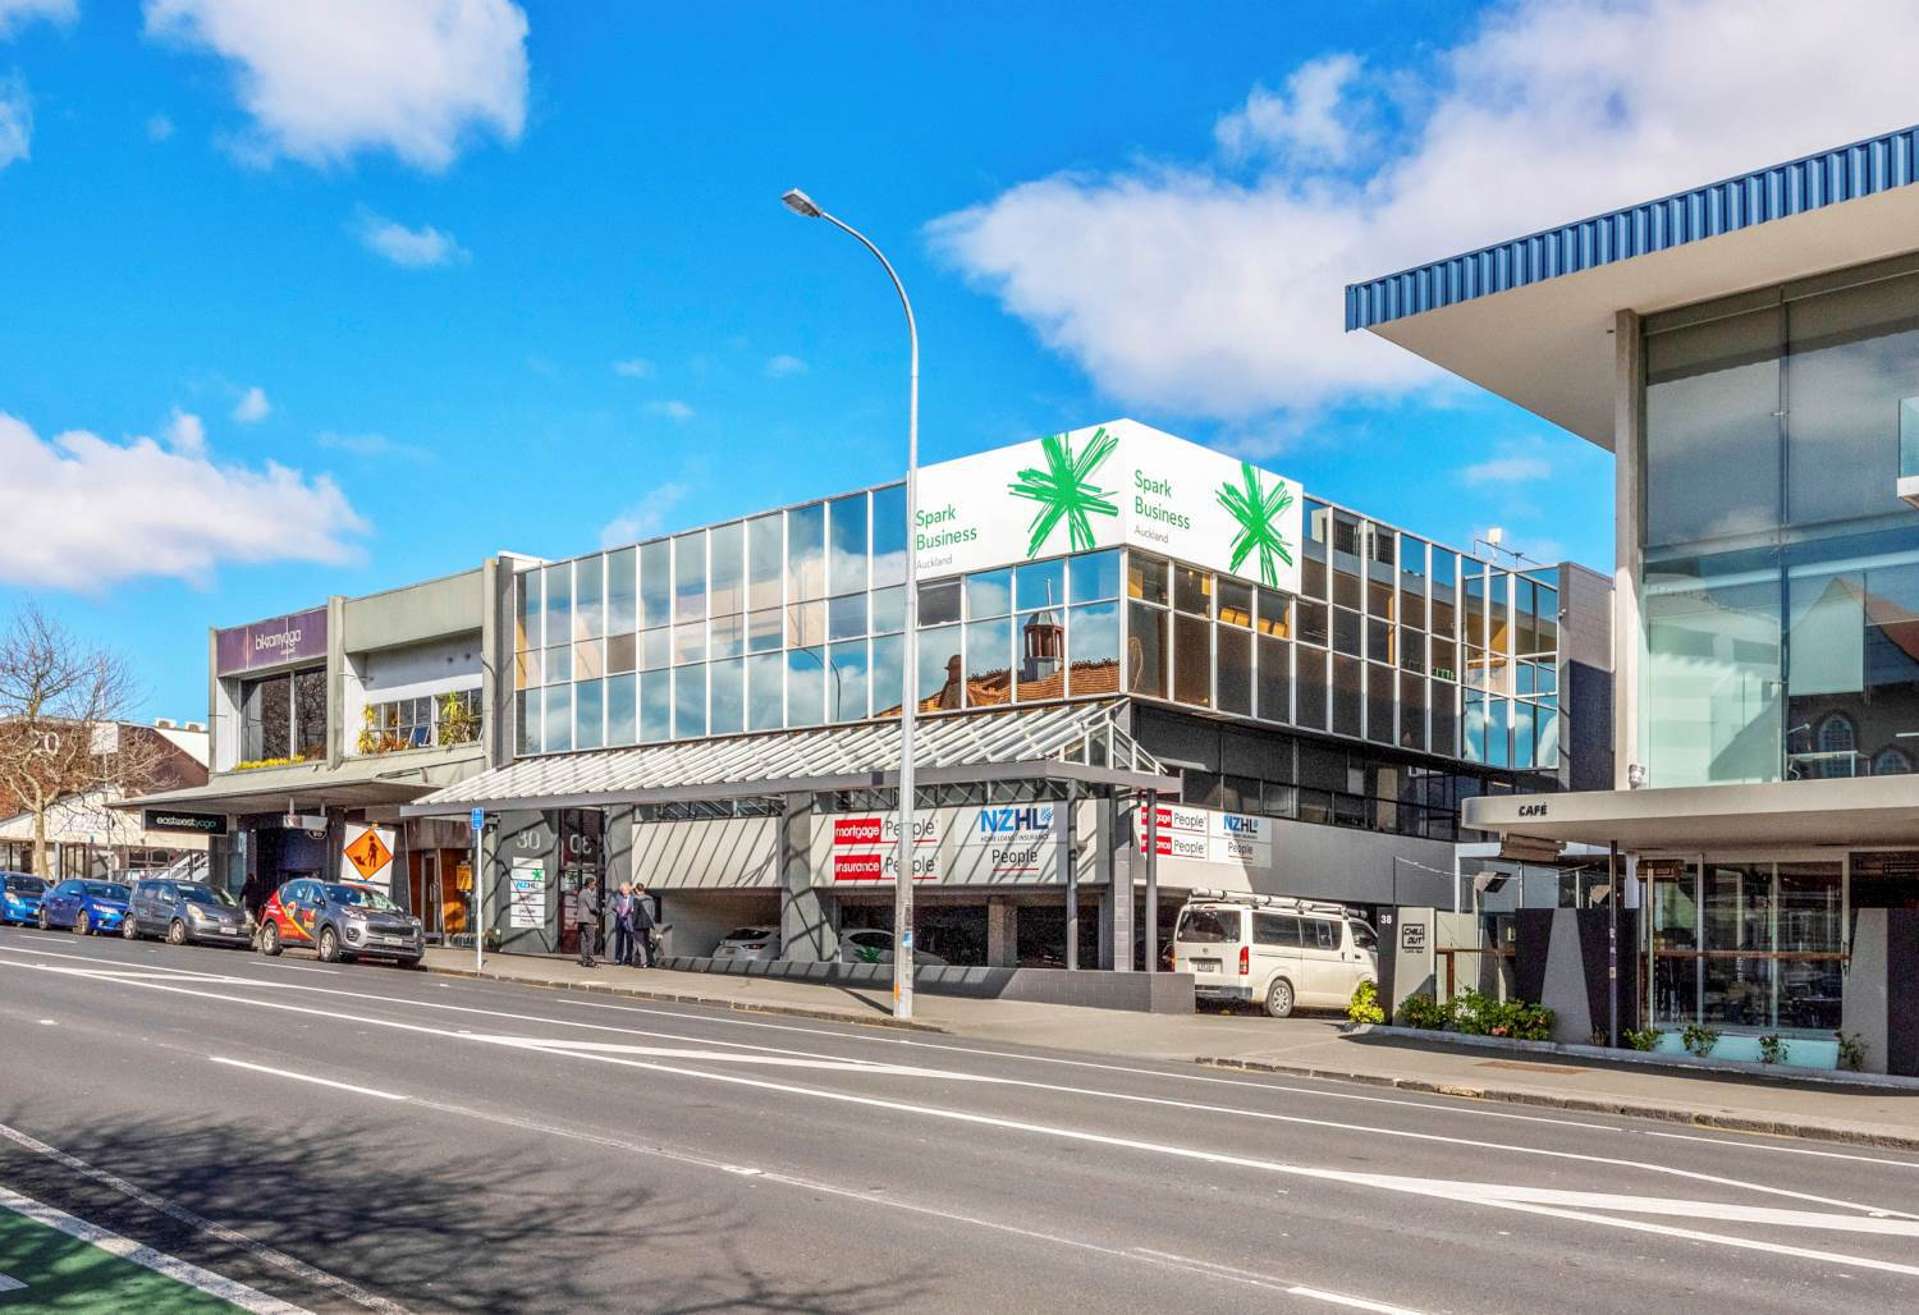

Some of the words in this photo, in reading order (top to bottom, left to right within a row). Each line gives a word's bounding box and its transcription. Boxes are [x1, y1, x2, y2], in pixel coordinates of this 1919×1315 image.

[1135, 469, 1172, 499] Spark
[915, 503, 956, 529] Spark
[1135, 495, 1191, 530] Business
[916, 528, 977, 551] Business
[1135, 524, 1169, 544] Auckland
[916, 553, 953, 569] Auckland
[1518, 802, 1548, 817] CAFÉ
[836, 825, 880, 839] mortgage
[885, 819, 935, 839] Peple
[980, 807, 1049, 833] NZHL
[1174, 812, 1205, 828] People
[1223, 815, 1257, 833] NZHL
[516, 830, 541, 850] 30
[1174, 839, 1205, 855] People
[837, 860, 880, 872] insurance
[885, 856, 935, 876] Peple
[992, 847, 1038, 866] People
[1380, 914, 1393, 925] 38
[1404, 927, 1424, 936] CHILL
[1406, 936, 1424, 945] OUT
